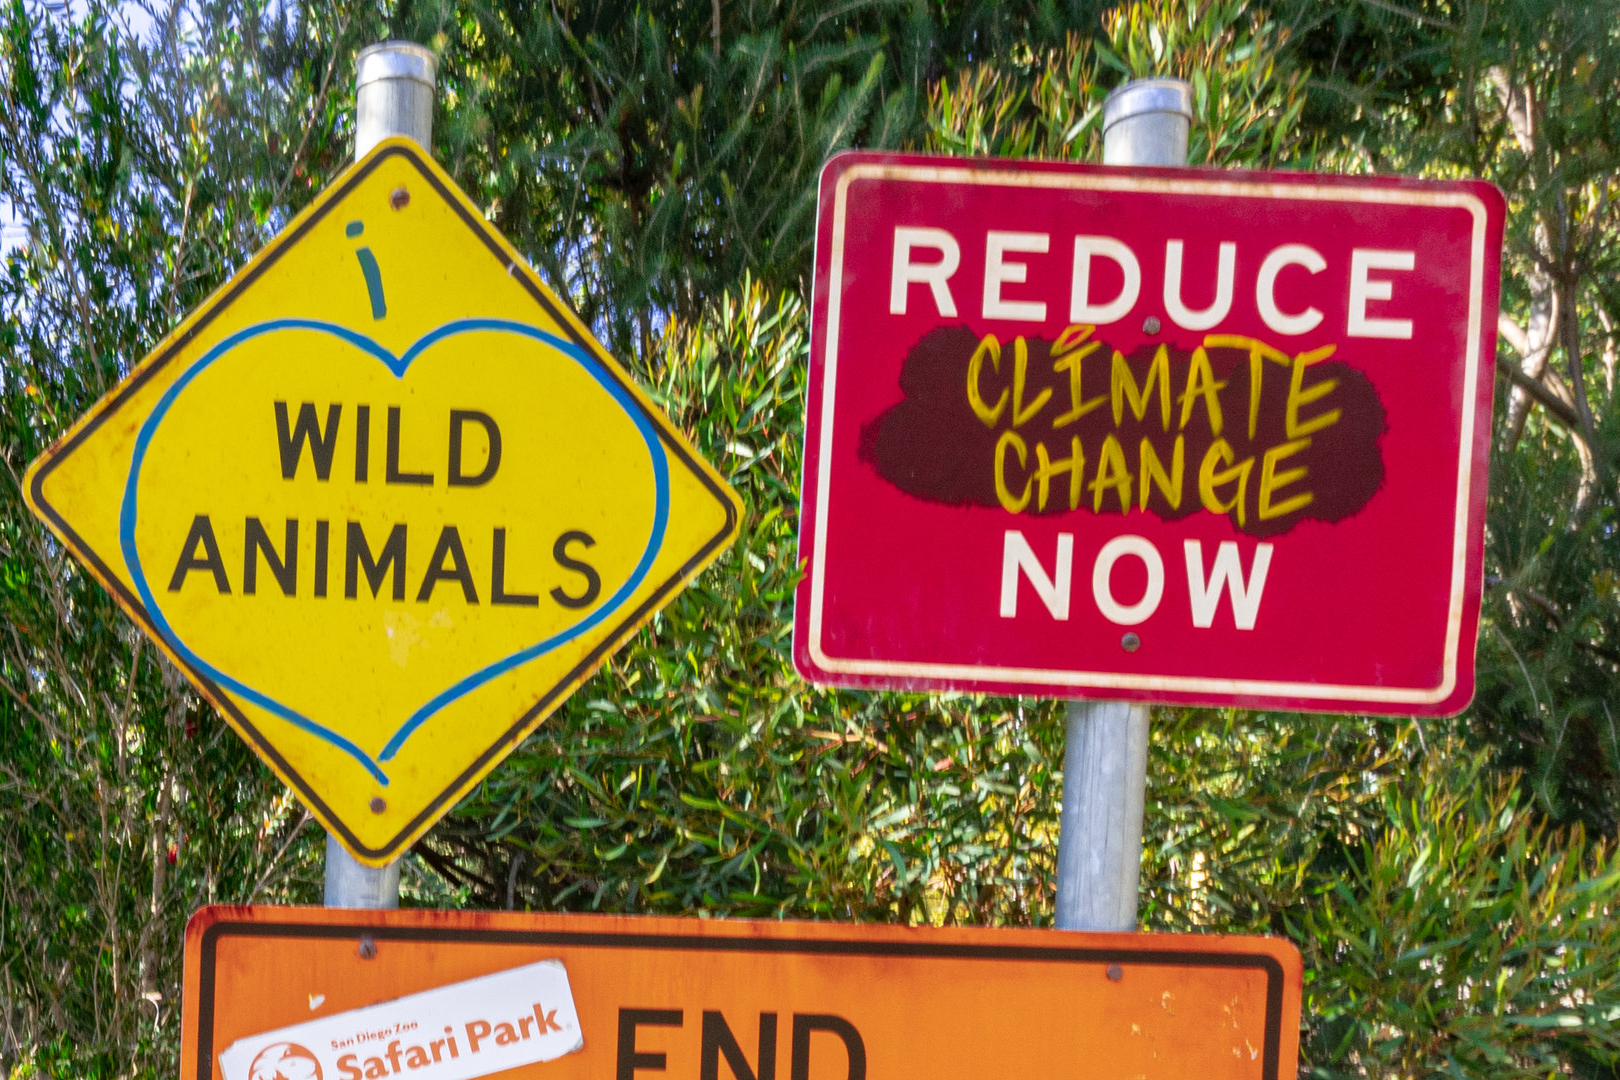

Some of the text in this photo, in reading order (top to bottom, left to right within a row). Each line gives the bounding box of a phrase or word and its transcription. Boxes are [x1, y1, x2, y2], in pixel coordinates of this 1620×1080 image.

[889, 226, 1416, 340] REDUCE
[967, 324, 1343, 440] CLIMATE
[273, 401, 503, 488] WILD
[994, 429, 1315, 529] CHANGE
[168, 514, 602, 609] ANIMALS
[1000, 530, 1274, 630] NOW
[464, 1002, 564, 1054] Park
